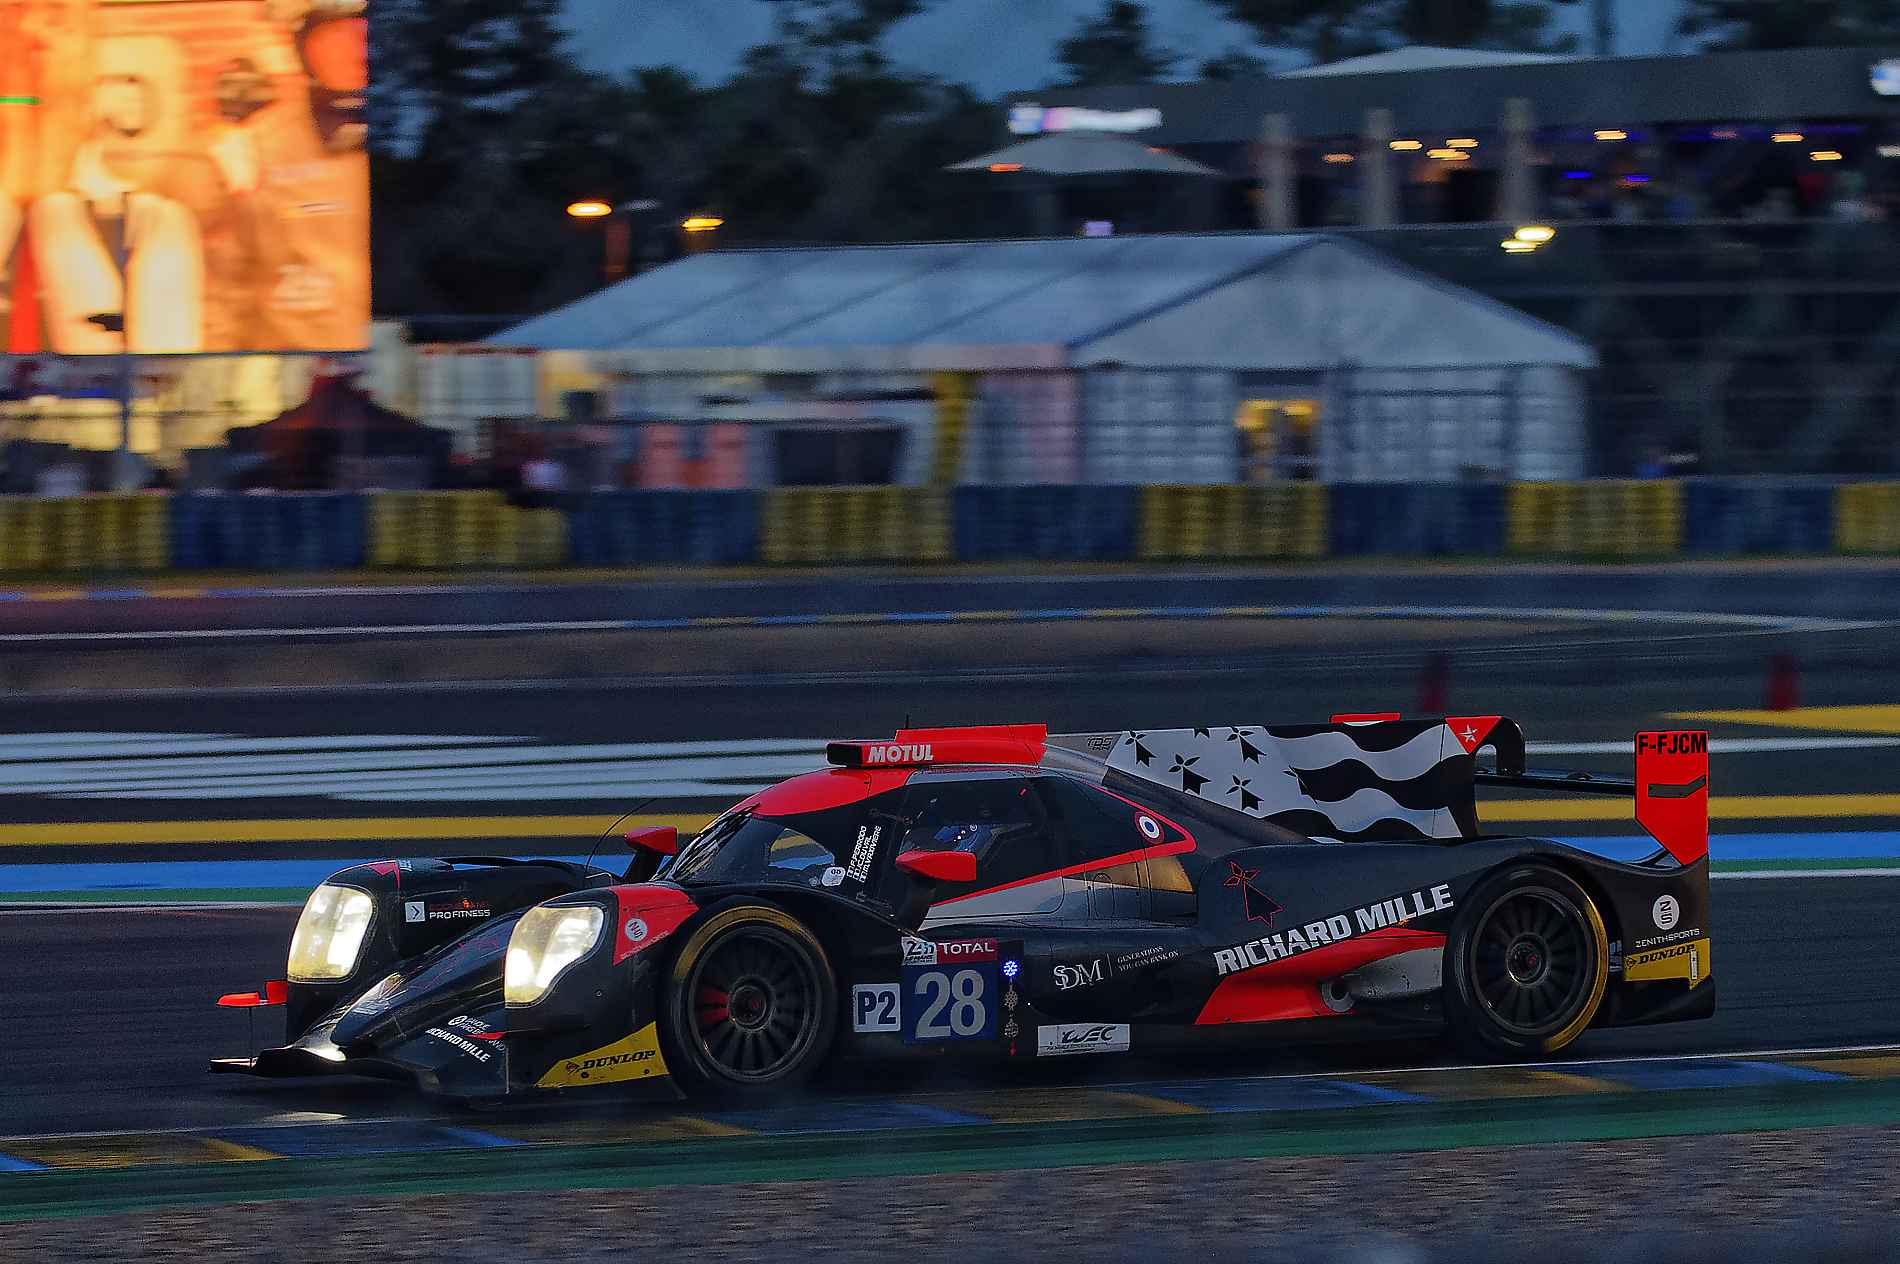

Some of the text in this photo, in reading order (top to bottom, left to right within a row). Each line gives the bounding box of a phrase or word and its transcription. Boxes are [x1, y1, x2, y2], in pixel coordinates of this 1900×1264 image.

[867, 744, 934, 763] MOTUL
[1638, 733, 1708, 754] F-FJCM
[1213, 884, 1453, 975] RICHARD MILLE
[938, 942, 994, 954] TOTAL
[1638, 944, 1695, 965] DUNLOP
[1054, 960, 1104, 990] SDM
[857, 991, 897, 1025] P2
[914, 969, 986, 1038] 28
[1061, 1025, 1116, 1043] WEC
[460, 1041, 491, 1062] MILLE
[582, 1050, 655, 1069] DUNLOP
